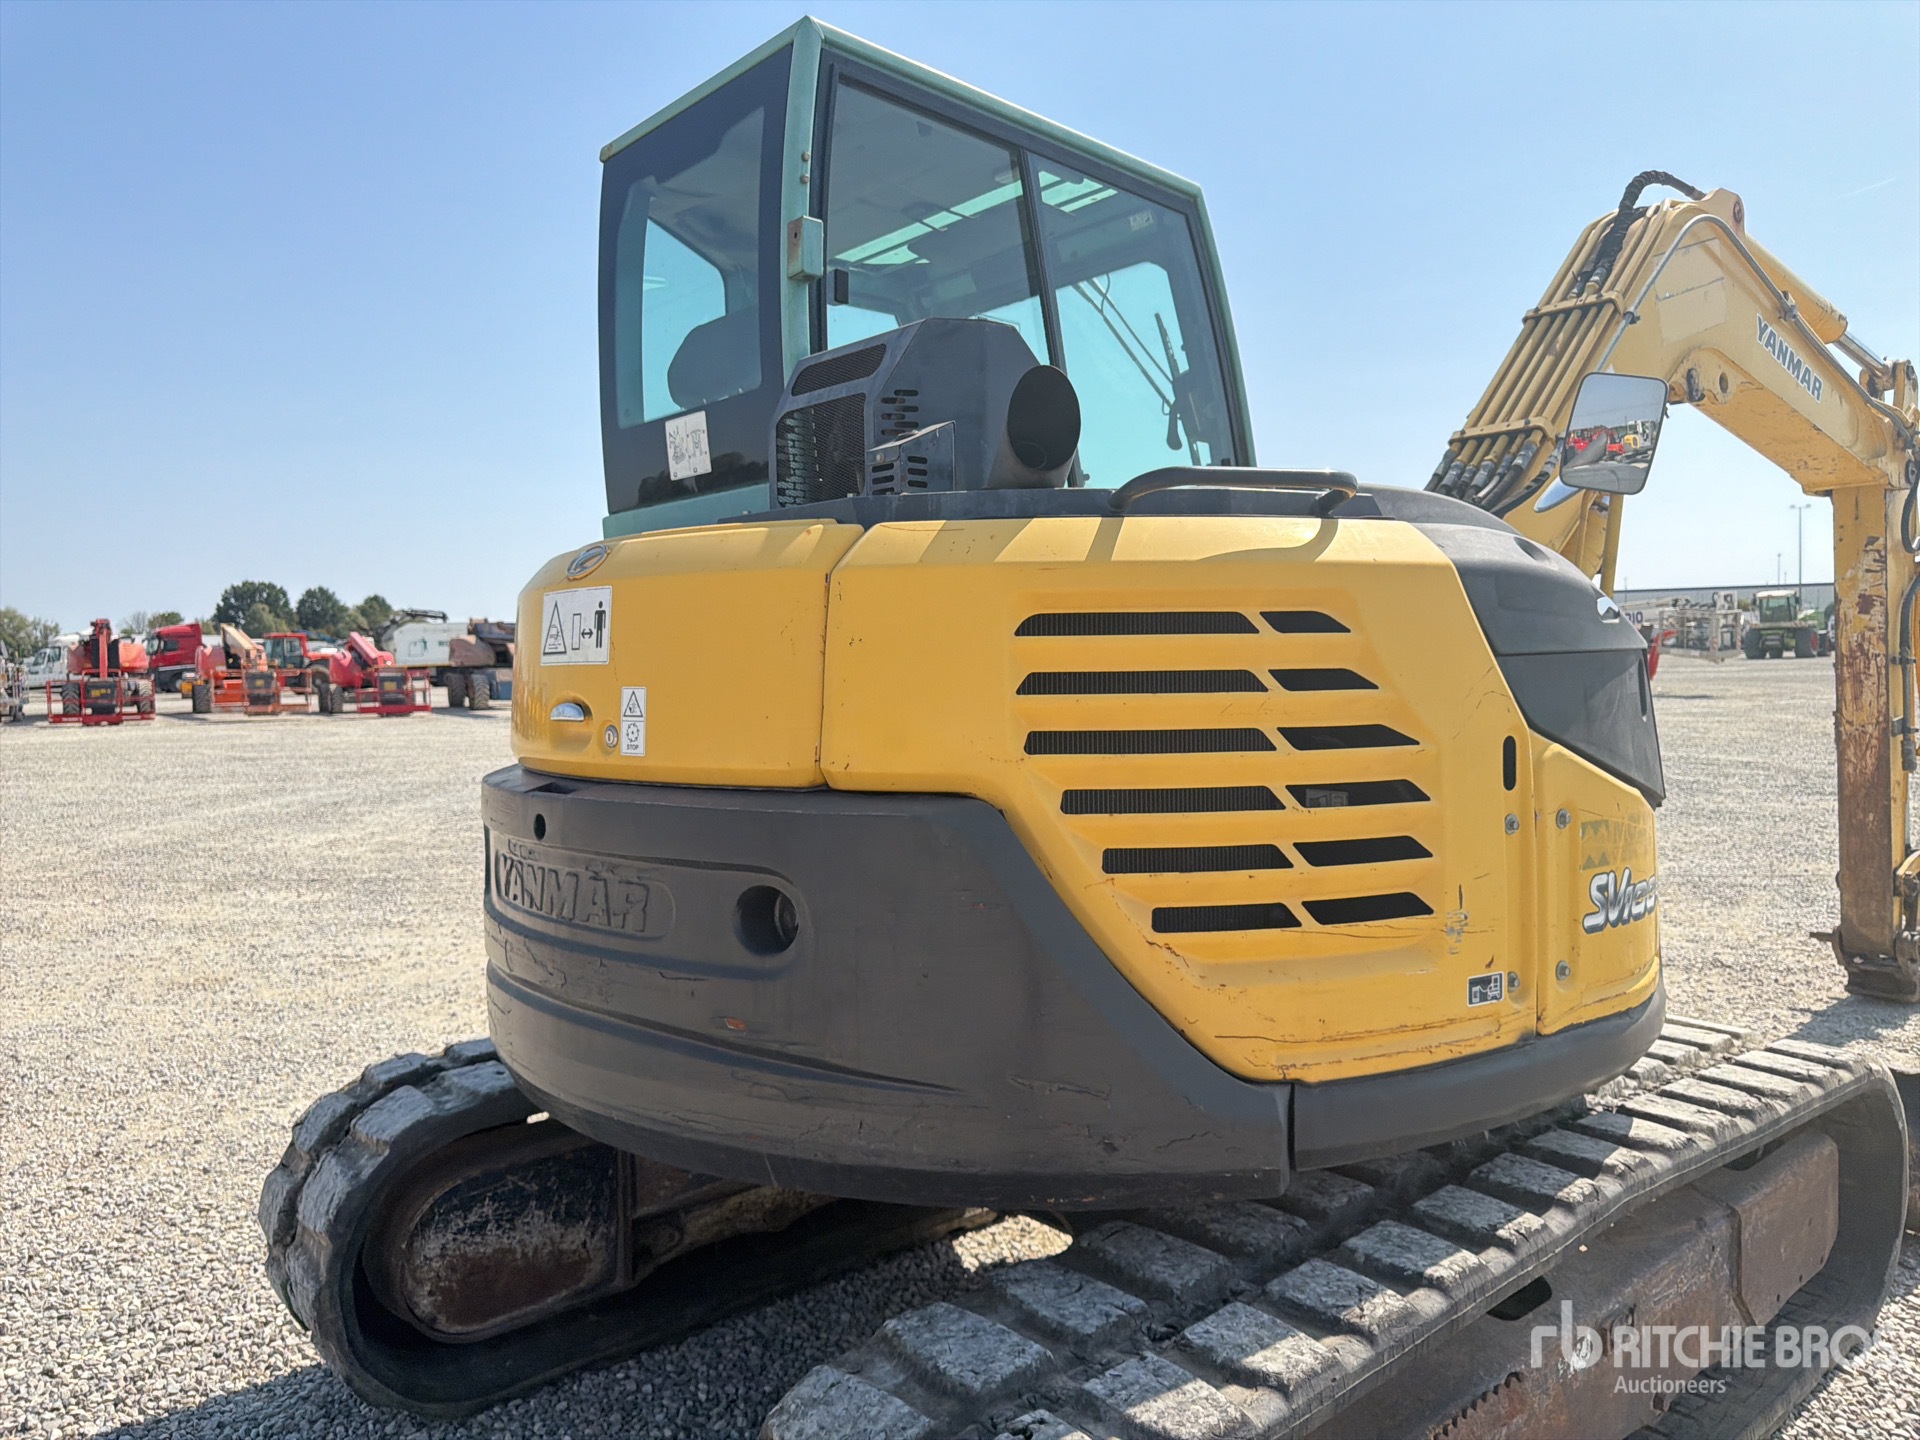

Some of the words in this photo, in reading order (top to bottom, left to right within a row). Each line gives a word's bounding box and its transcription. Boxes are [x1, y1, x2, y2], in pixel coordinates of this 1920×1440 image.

[1756, 312, 1823, 403] YANMAR
[626, 743, 639, 751] STOP
[500, 852, 650, 933] YANMAR
